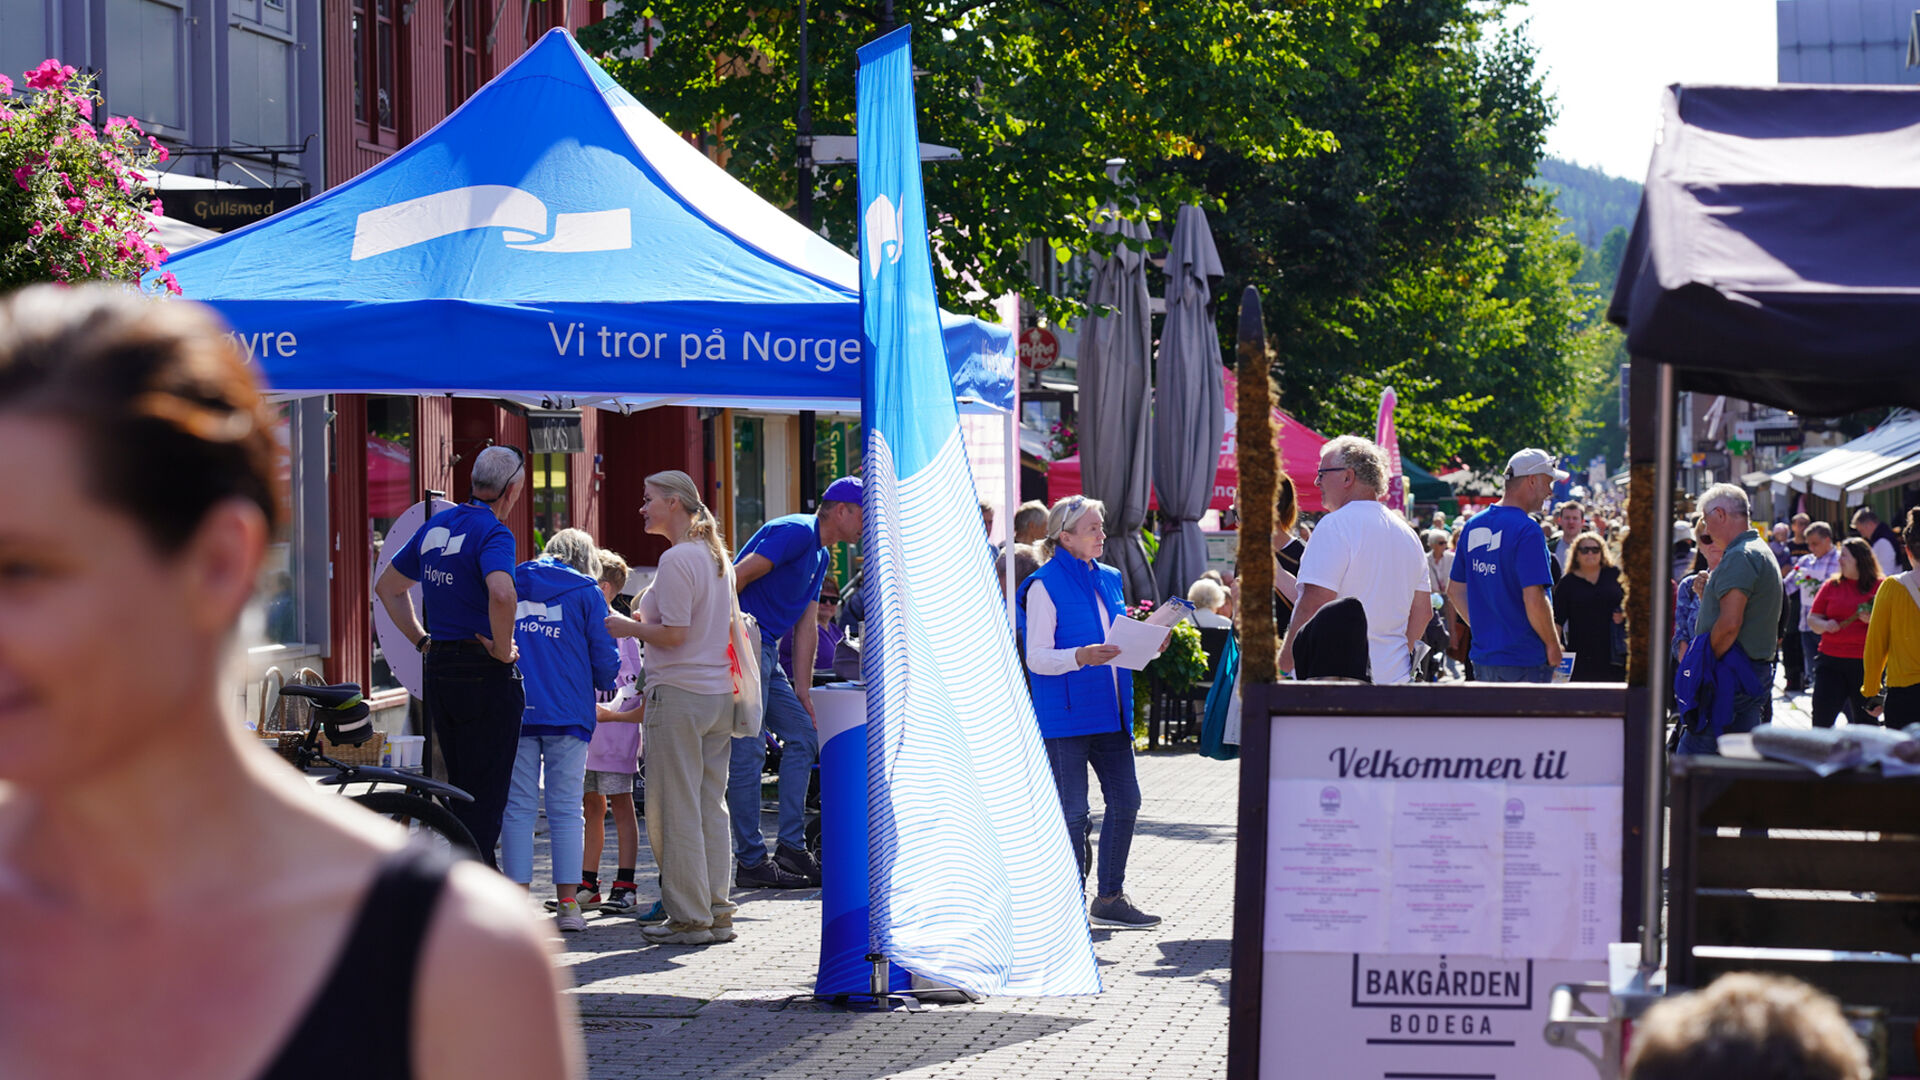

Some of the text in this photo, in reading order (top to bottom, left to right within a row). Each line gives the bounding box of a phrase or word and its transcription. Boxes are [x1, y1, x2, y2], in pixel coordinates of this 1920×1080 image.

[194, 200, 275, 220] Gullsmed
[220, 330, 298, 366] øyre
[548, 321, 862, 372] Vi tror på Norge
[424, 564, 454, 586] Høyre
[1472, 558, 1497, 577] Høyre
[519, 621, 561, 639] HØYRE
[1328, 747, 1570, 780] Velkommen til
[1366, 961, 1521, 998] BAKGÅRDEN
[1390, 1013, 1493, 1036] BODEGA
